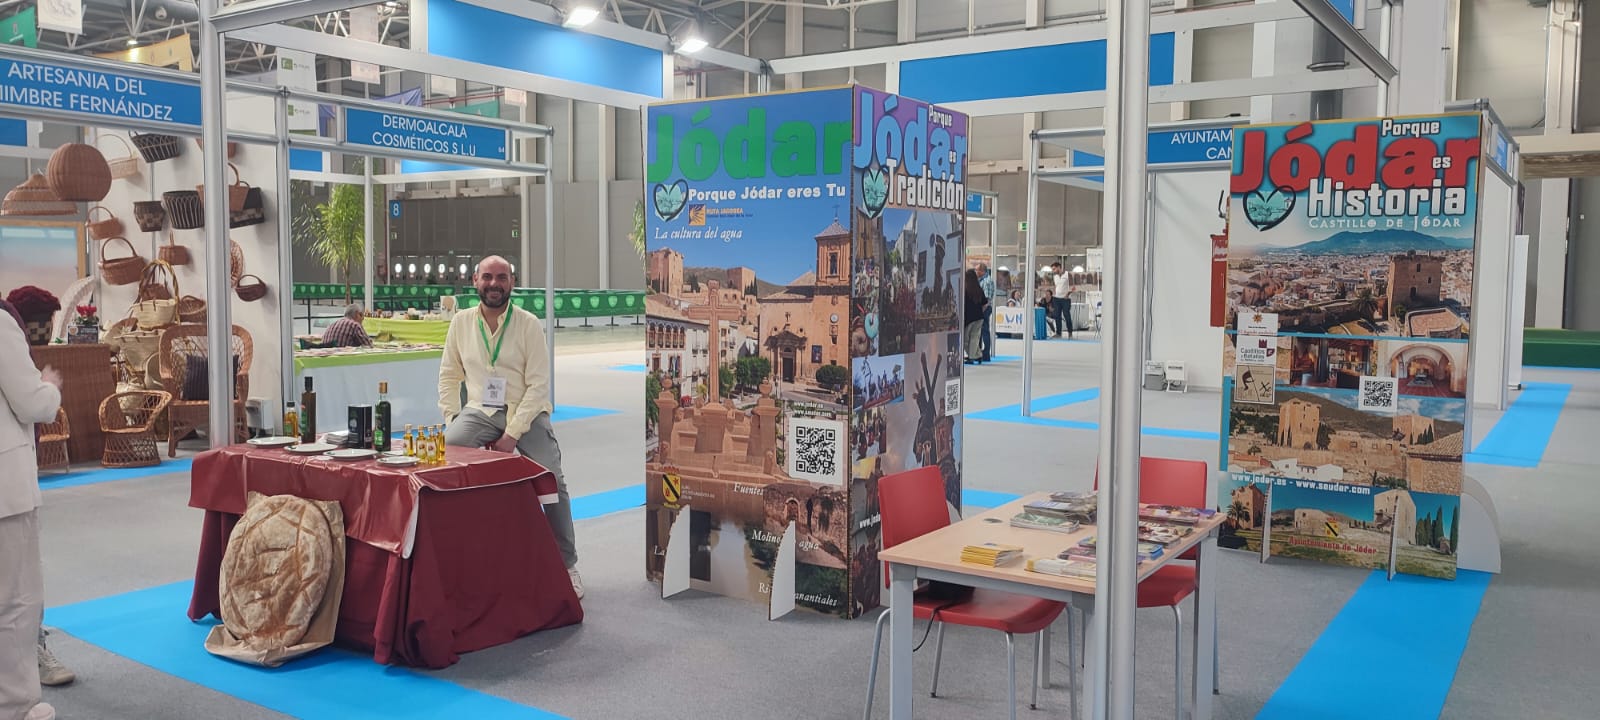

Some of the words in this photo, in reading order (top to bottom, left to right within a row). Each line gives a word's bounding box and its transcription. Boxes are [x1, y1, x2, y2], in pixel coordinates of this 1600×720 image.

[8, 62, 109, 91] ARTESANIA
[115, 77, 147, 96] DEL
[0, 84, 63, 108] IMBRE
[70, 93, 173, 121] FERNÁNDEZ
[382, 114, 467, 139] DERMOALCALÁ
[928, 104, 953, 129] Porque
[854, 91, 967, 183] Jódar
[1171, 130, 1233, 145] AYUNTAM
[1381, 119, 1440, 138] Porque
[372, 131, 449, 153] COSMÉTICOS
[647, 105, 851, 183] Jódar
[949, 150, 957, 163] es
[1230, 122, 1480, 193] Jódar
[1432, 156, 1452, 169] es
[689, 187, 736, 203] Porque
[741, 186, 783, 200] Jódar
[787, 186, 821, 199] eres
[826, 183, 846, 197] Tu
[886, 158, 964, 211] Tradición
[1307, 178, 1466, 218] Historia
[393, 203, 399, 216] 8
[655, 228, 668, 239] La
[670, 227, 701, 239] cultura
[704, 226, 718, 238] del
[720, 230, 743, 242] agua
[1309, 217, 1377, 230] CASTILLO
[1386, 218, 1403, 229] DE
[734, 483, 764, 496] Fuentes
[752, 529, 783, 544] Molino
[799, 539, 819, 551] agua
[794, 592, 837, 606] anantiales
